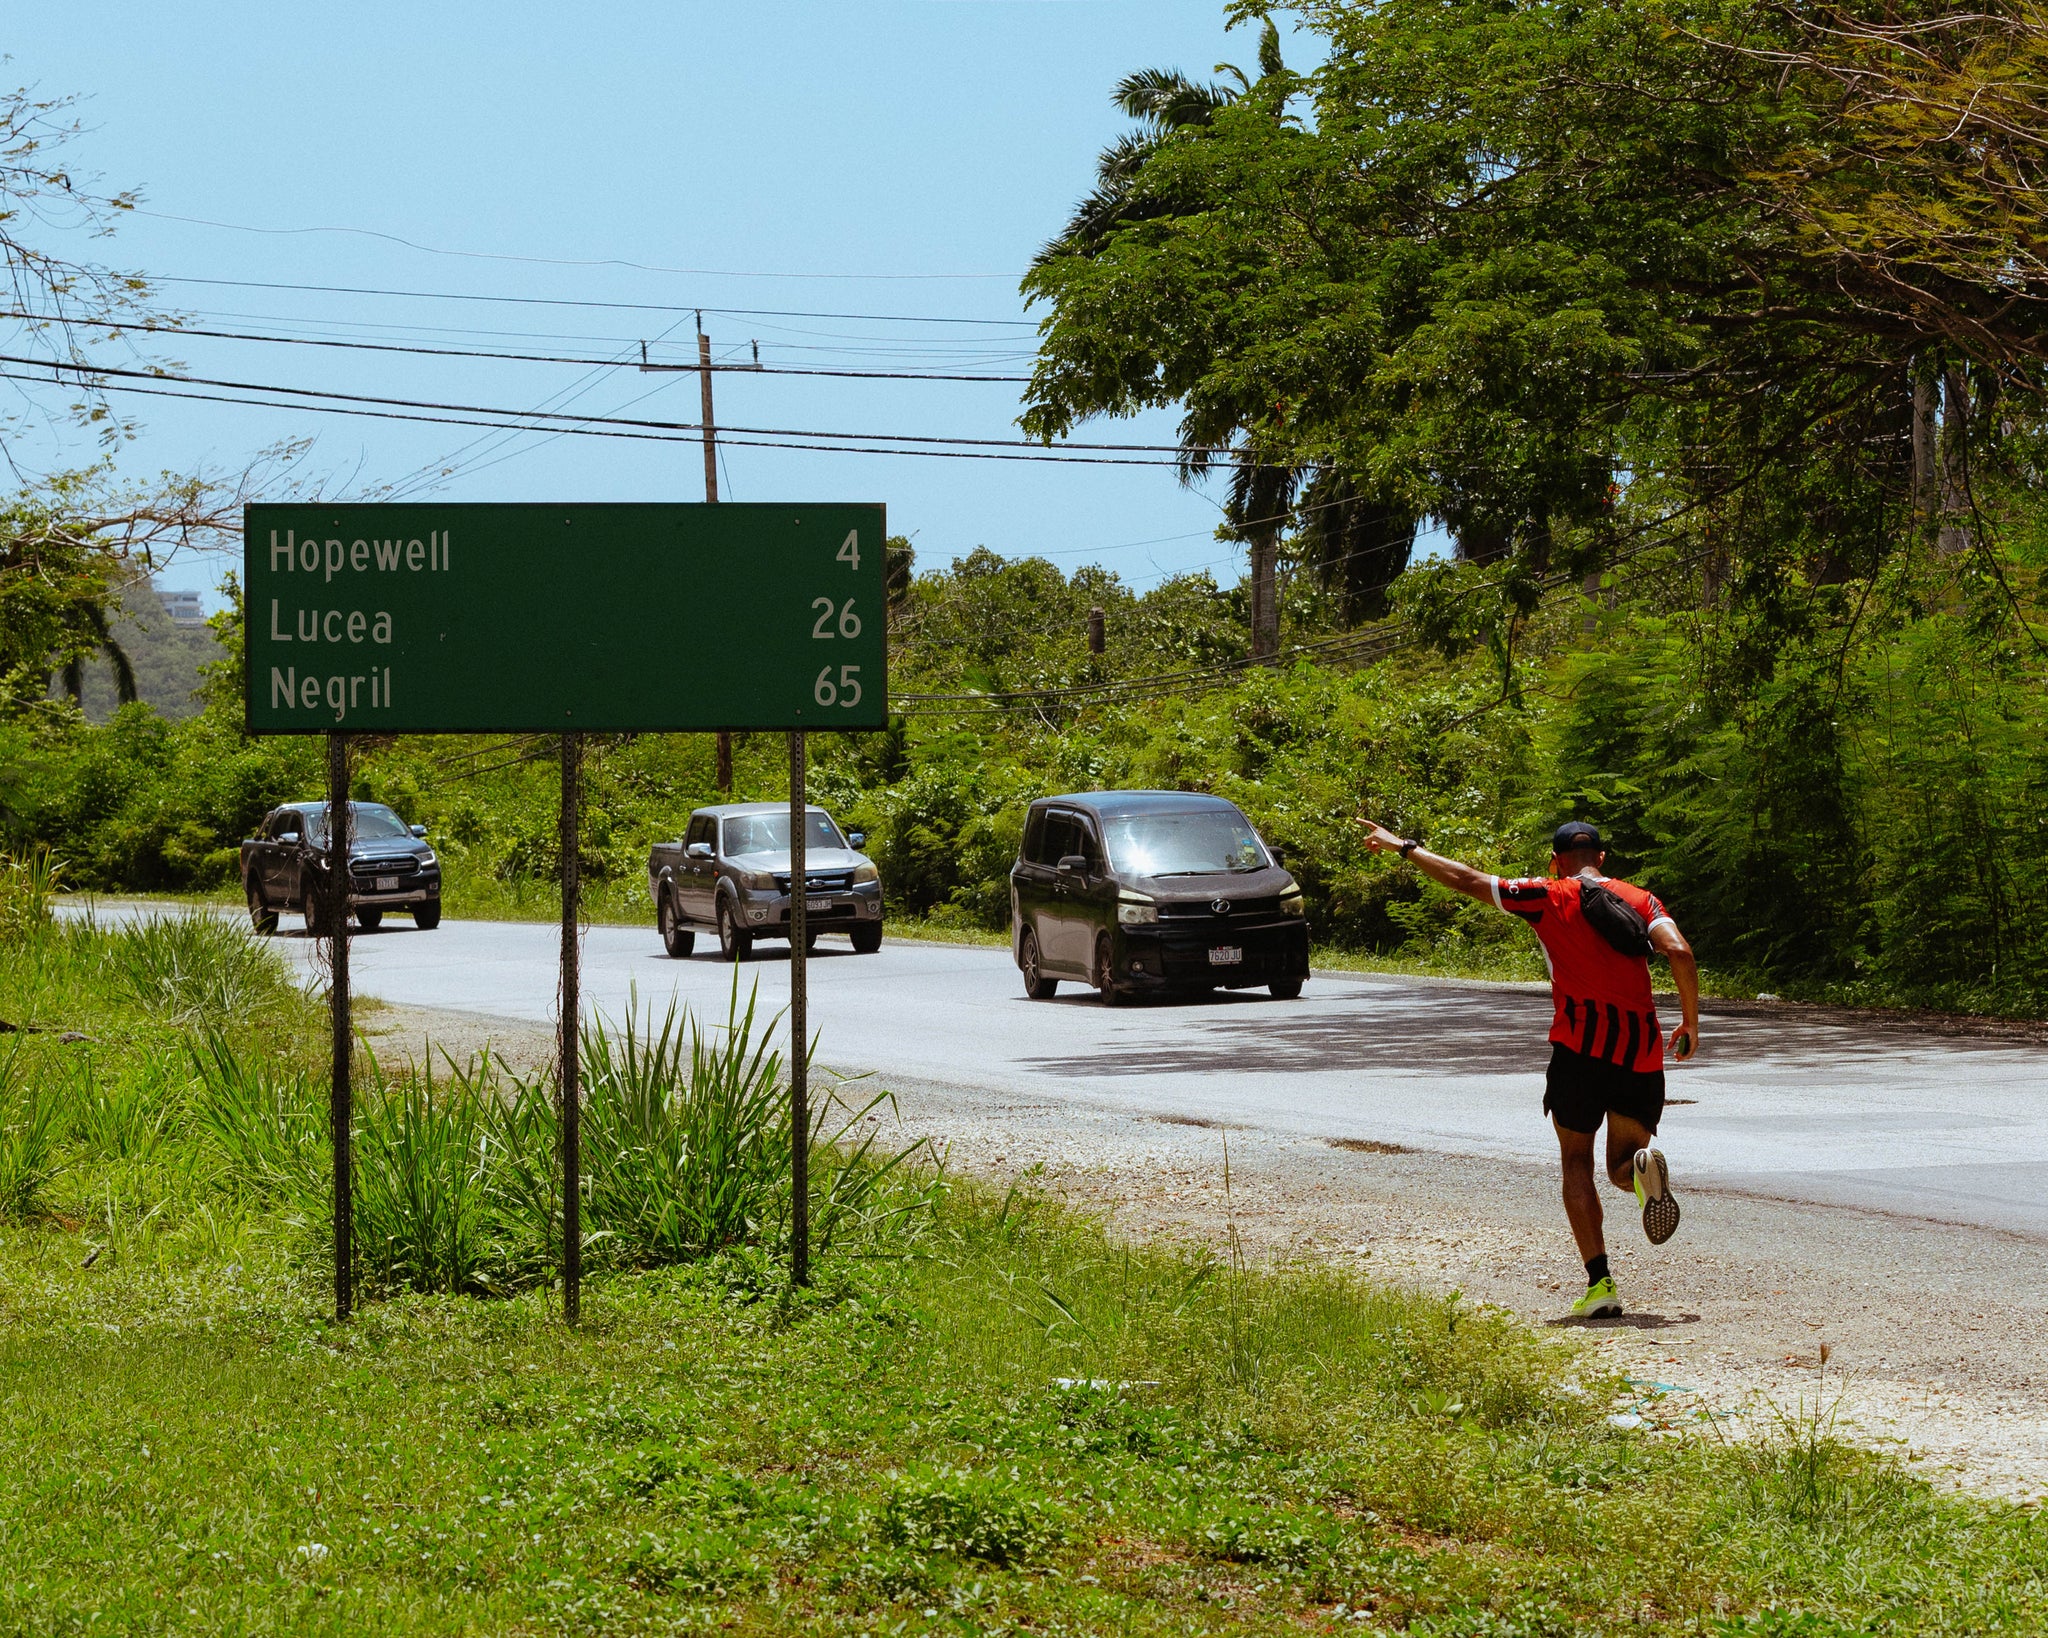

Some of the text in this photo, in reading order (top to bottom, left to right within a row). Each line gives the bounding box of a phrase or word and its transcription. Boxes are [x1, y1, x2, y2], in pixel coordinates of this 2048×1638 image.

[270, 529, 861, 583] Hopewell 4
[270, 597, 862, 643] Lucea 26
[270, 665, 862, 723] Negril 65
[1210, 950, 1241, 960] 7620 JU
